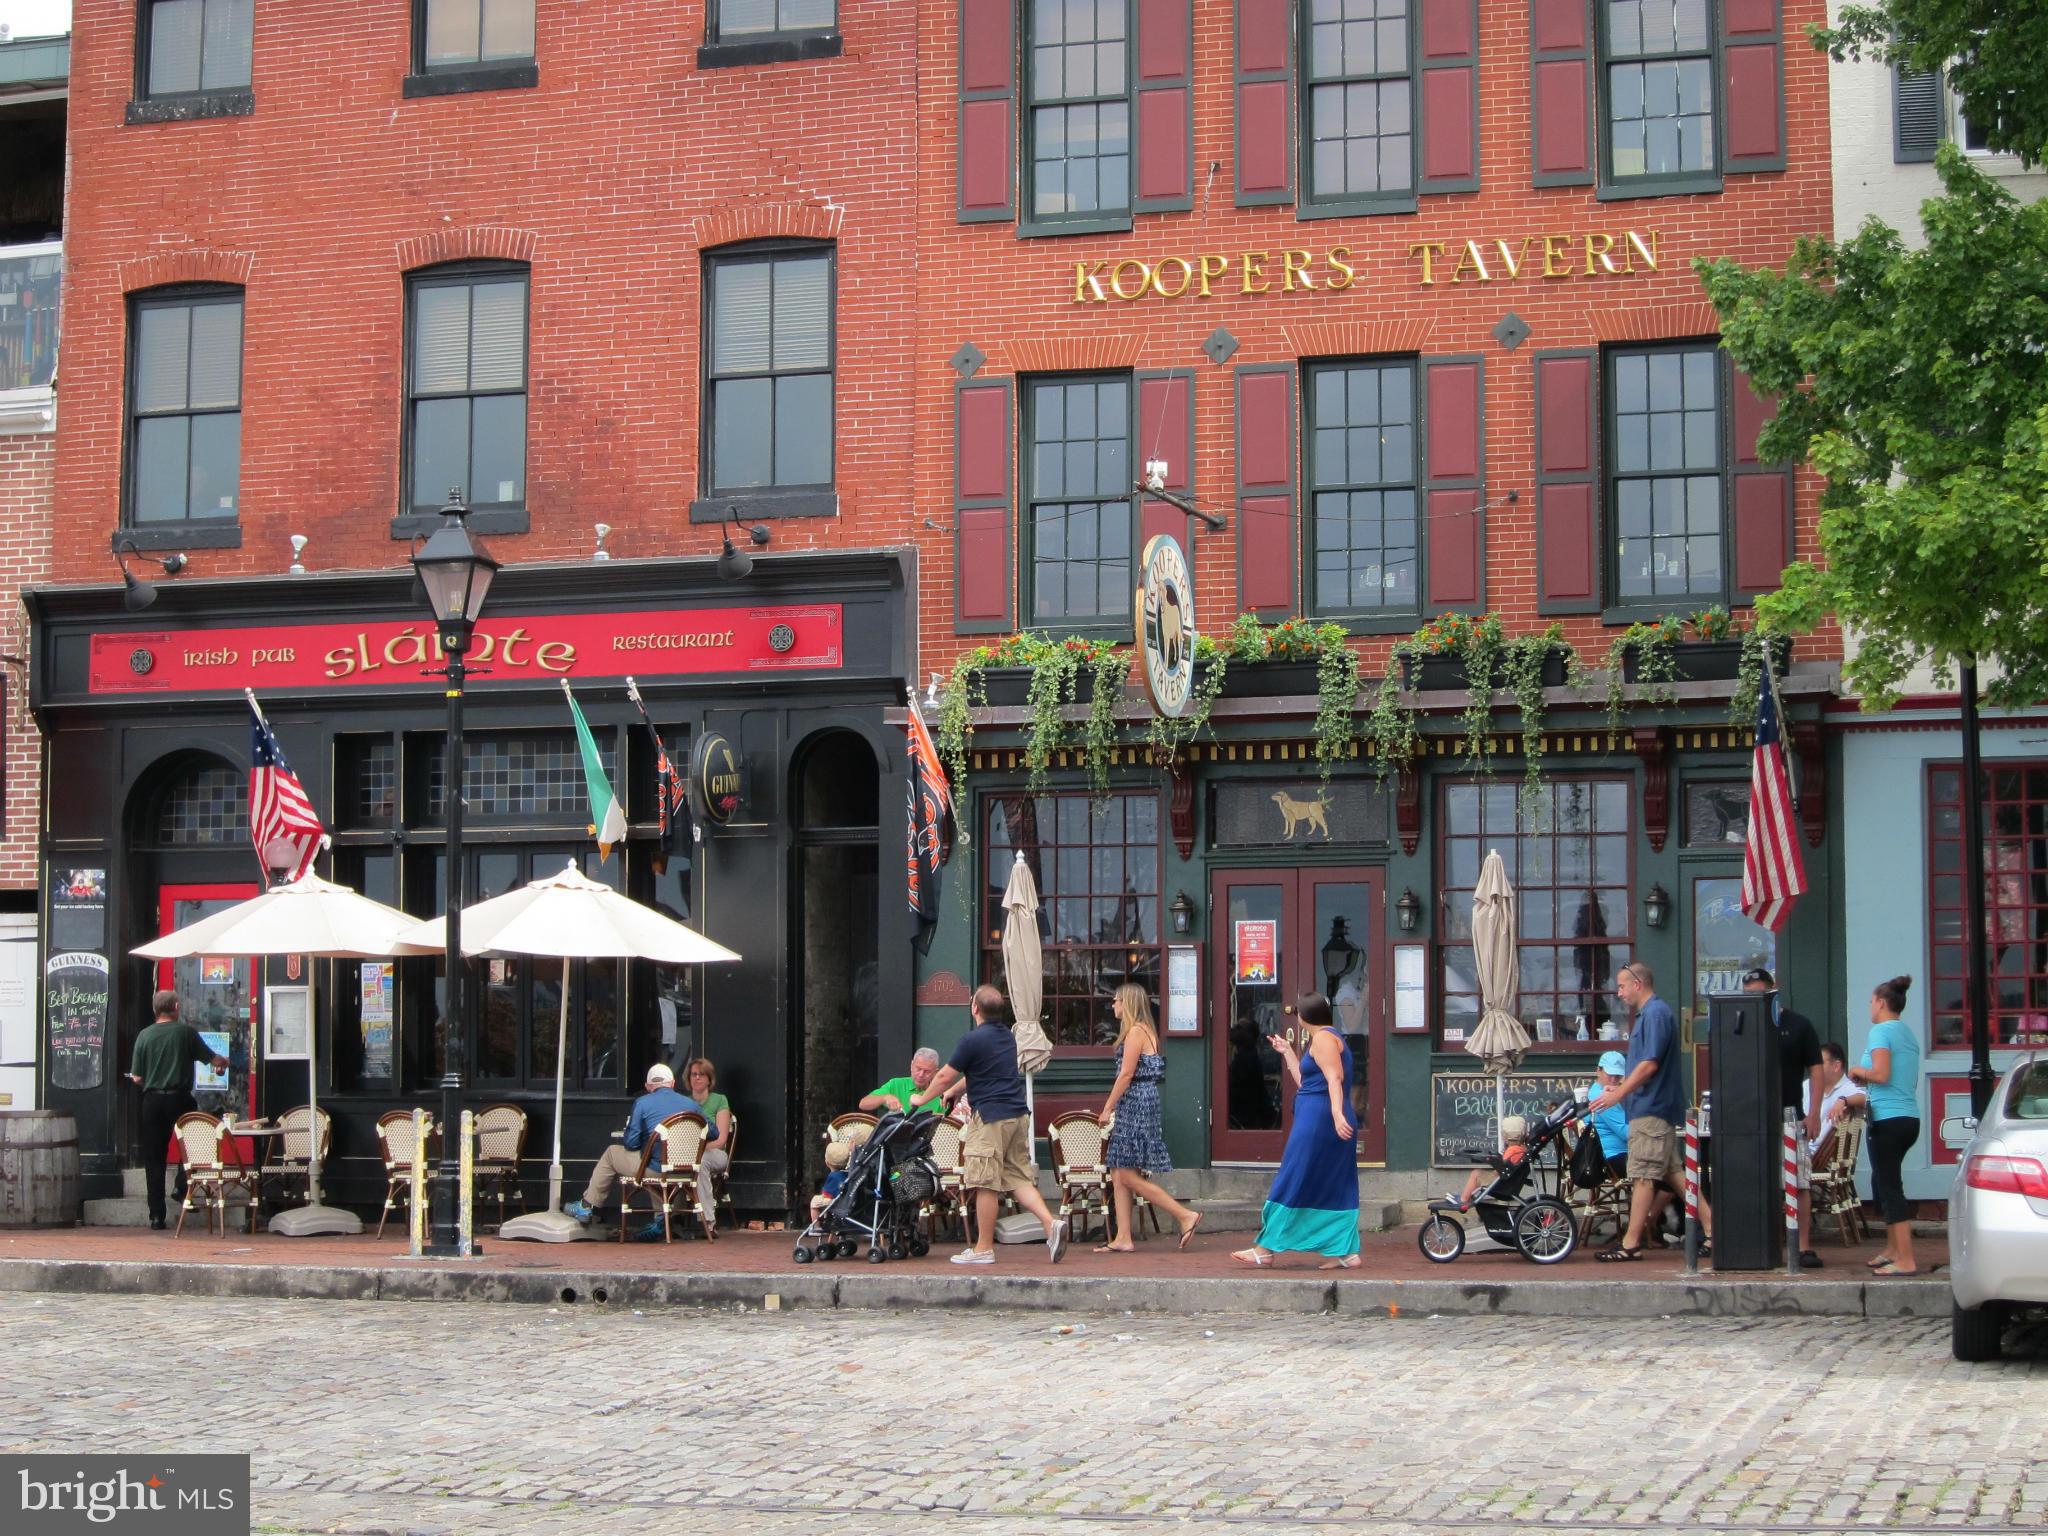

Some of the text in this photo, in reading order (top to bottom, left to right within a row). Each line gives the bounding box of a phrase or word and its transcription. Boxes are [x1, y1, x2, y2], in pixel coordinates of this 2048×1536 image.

[1073, 229, 1660, 304] KOOPERS TAVERN
[51, 954, 104, 969] GUINNESS
[1542, 1078, 1591, 1094] TAVE
